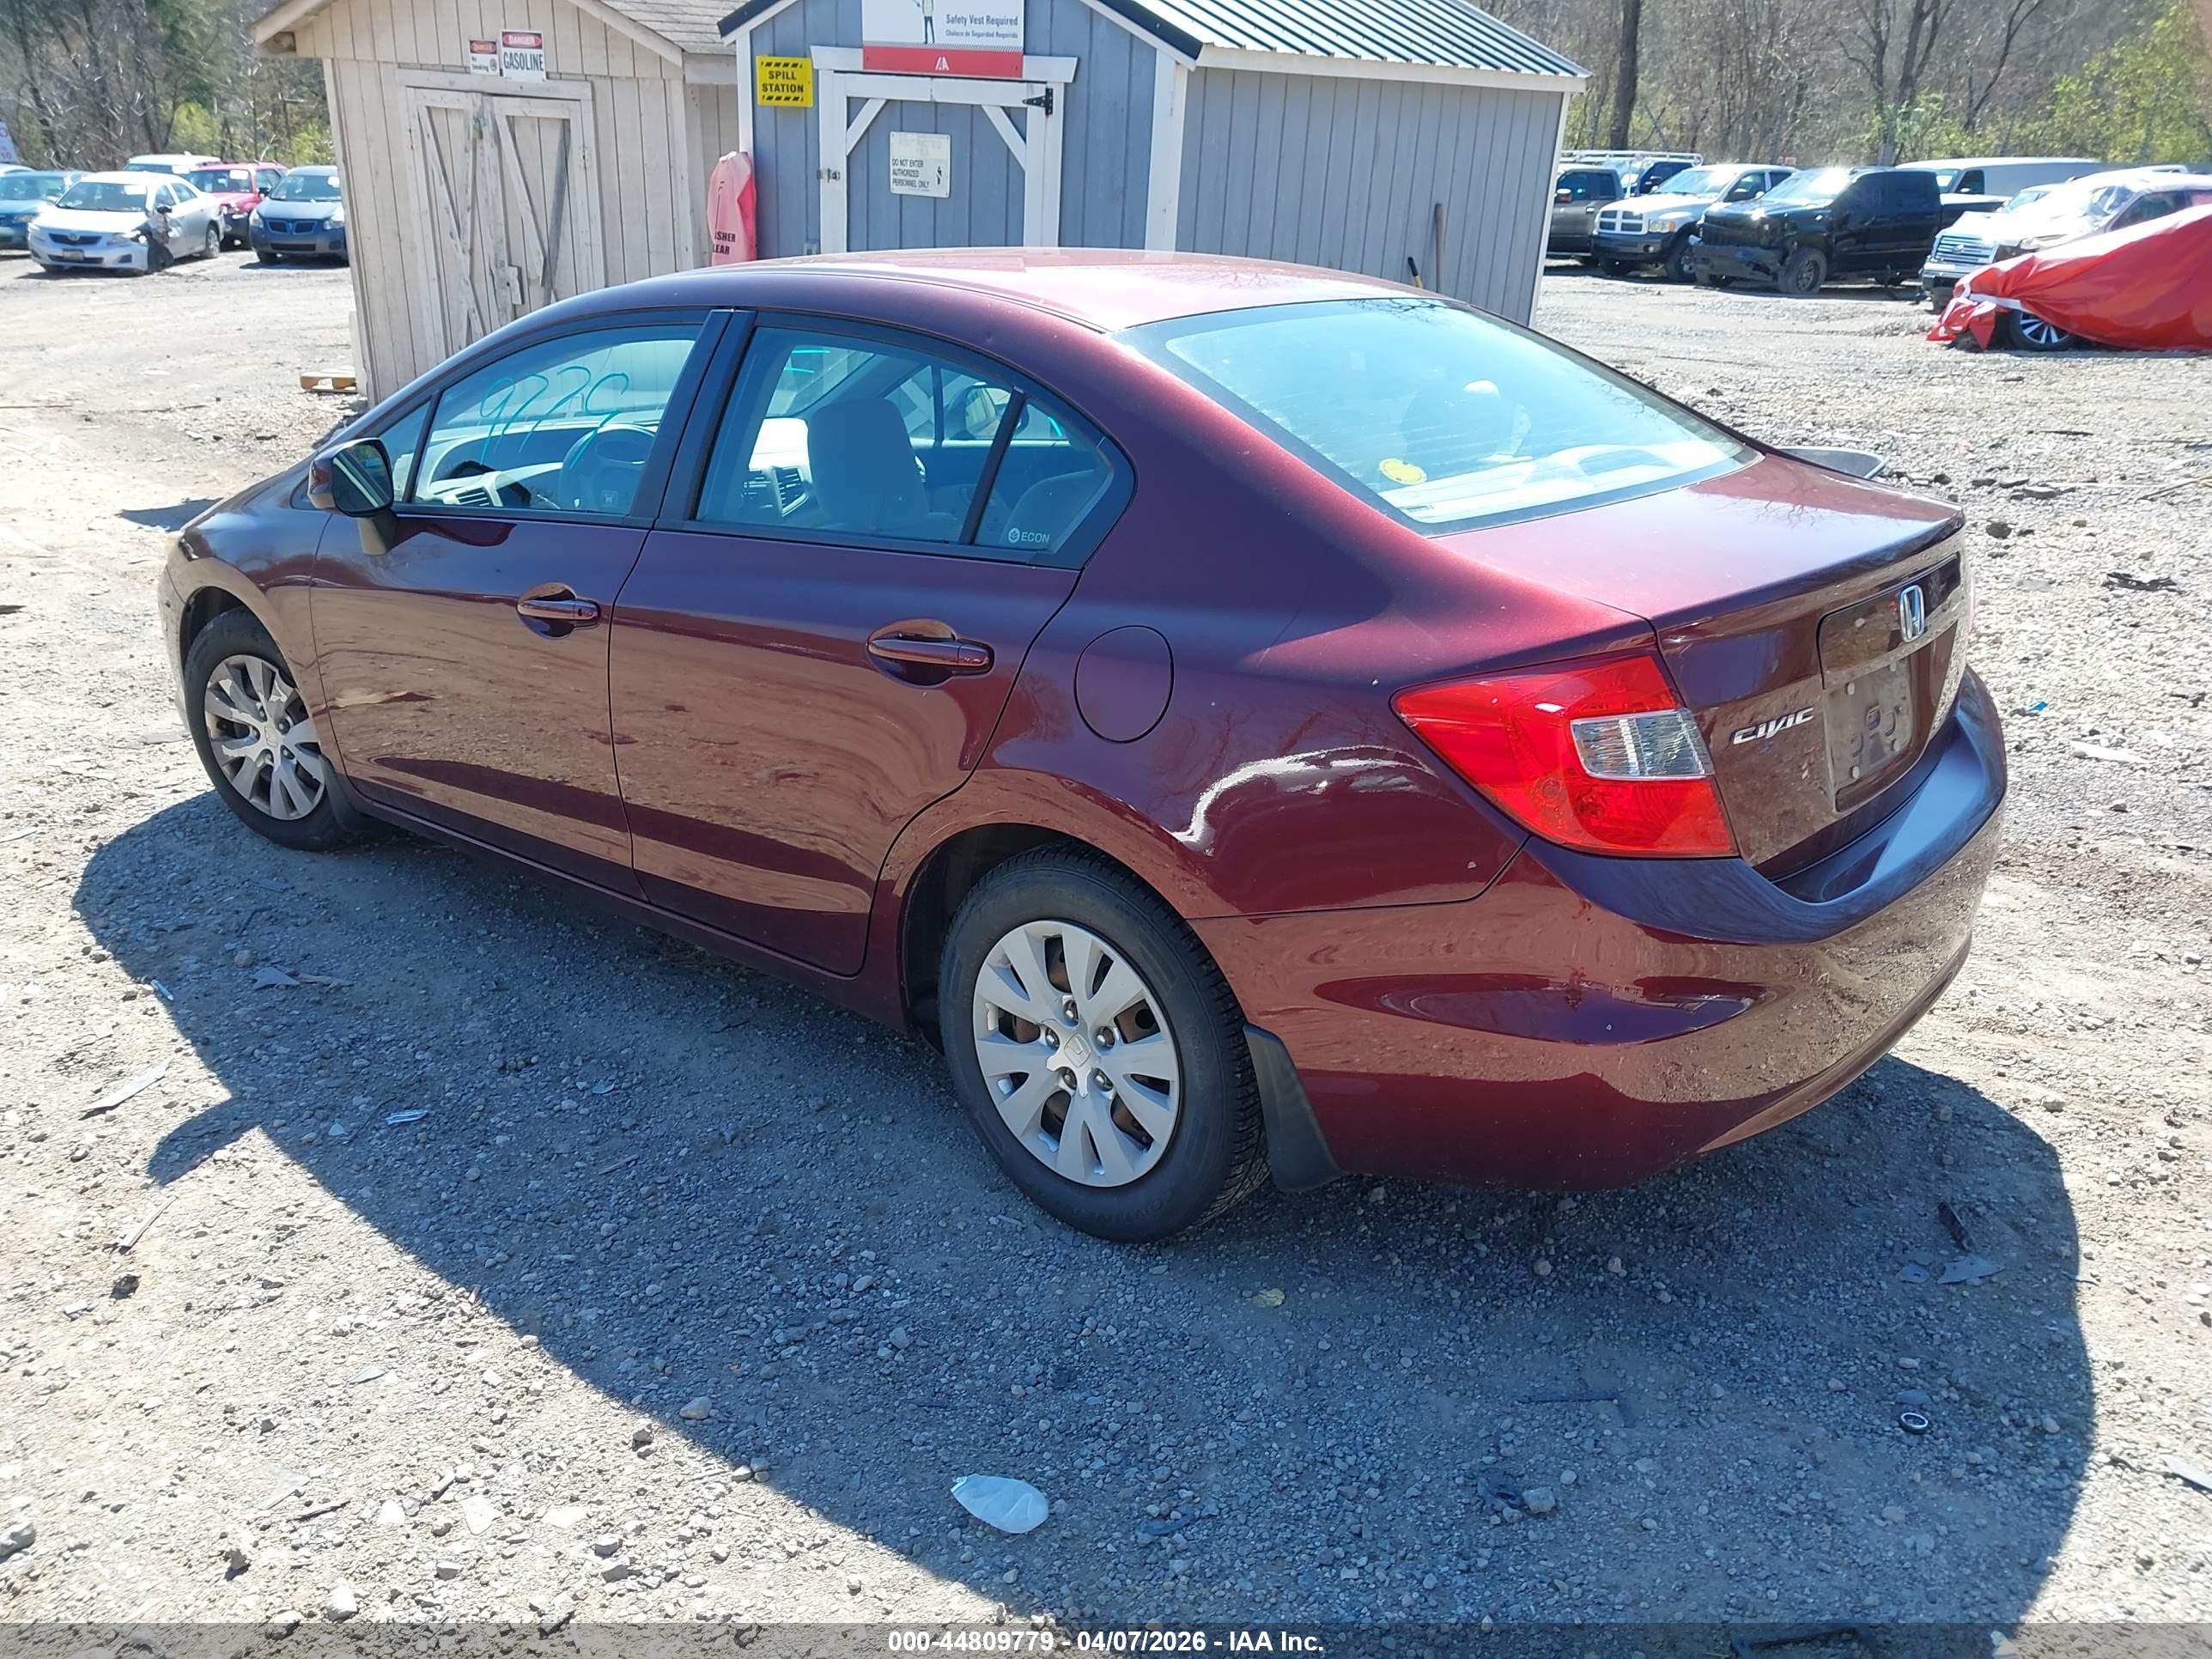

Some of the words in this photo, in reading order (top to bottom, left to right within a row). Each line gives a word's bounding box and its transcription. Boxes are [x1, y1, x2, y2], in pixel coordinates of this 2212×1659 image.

[945, 14, 967, 27] Safety
[969, 14, 985, 25] Vest
[986, 15, 1018, 27] Required
[971, 30, 994, 39] Seguridad
[503, 52, 544, 71] GASOLINE
[769, 70, 798, 81] SPILL
[762, 83, 805, 94] STATION
[892, 158, 899, 167] DO
[909, 159, 923, 168] ENTER
[893, 168, 920, 178] AUTHORIZED
[893, 178, 917, 187] PERSONNEL
[918, 179, 930, 189] ONLY
[1021, 532, 1050, 543] ECON
[1732, 707, 1814, 745] CIVIC
